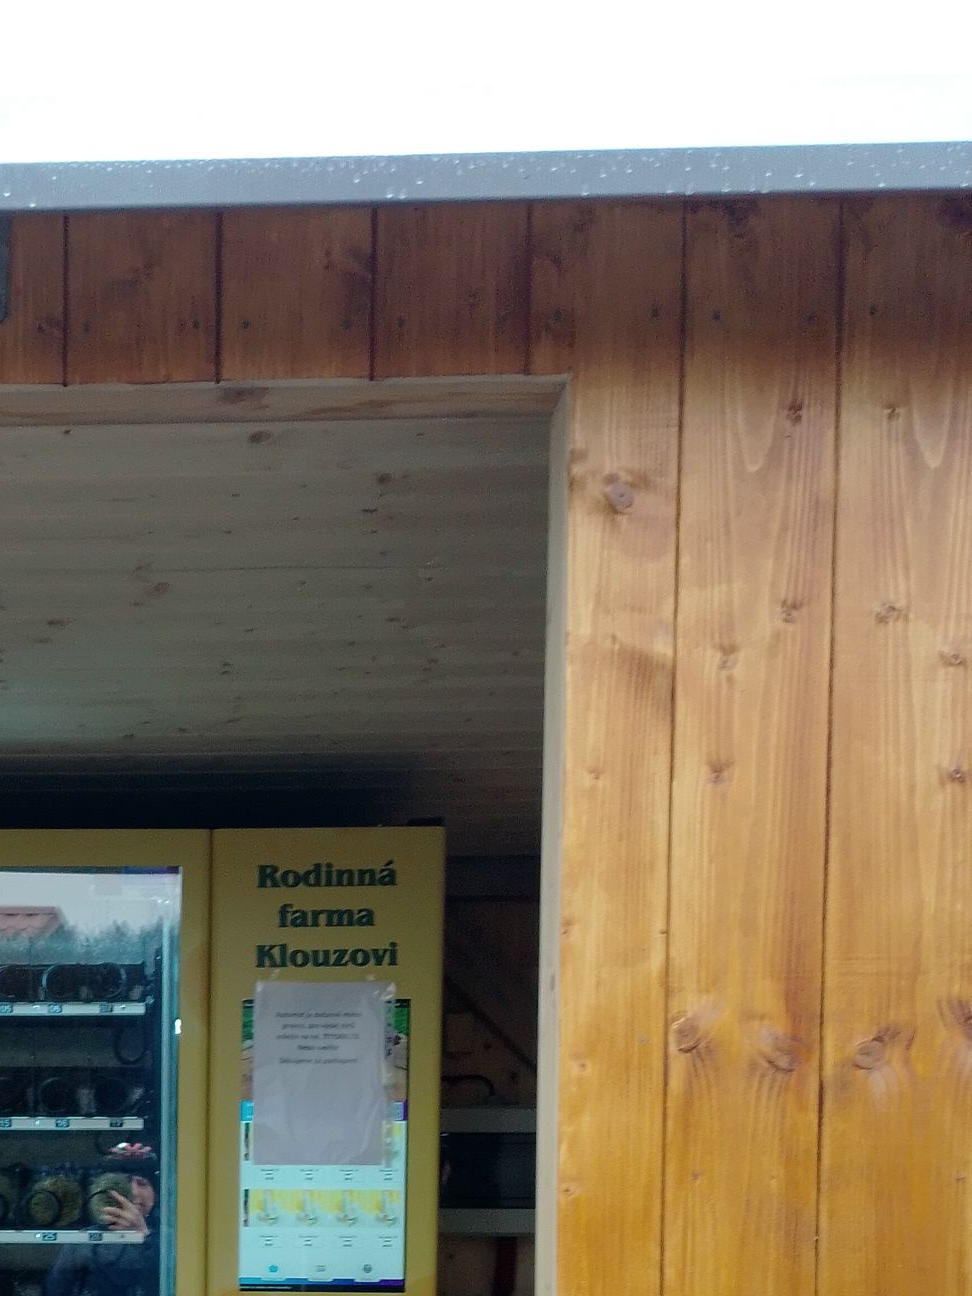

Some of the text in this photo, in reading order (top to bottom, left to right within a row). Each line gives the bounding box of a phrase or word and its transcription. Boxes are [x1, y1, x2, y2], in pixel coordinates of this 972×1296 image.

[257, 860, 397, 889] Rodinná
[277, 903, 375, 928] farma
[255, 941, 398, 968] Klouzovi
